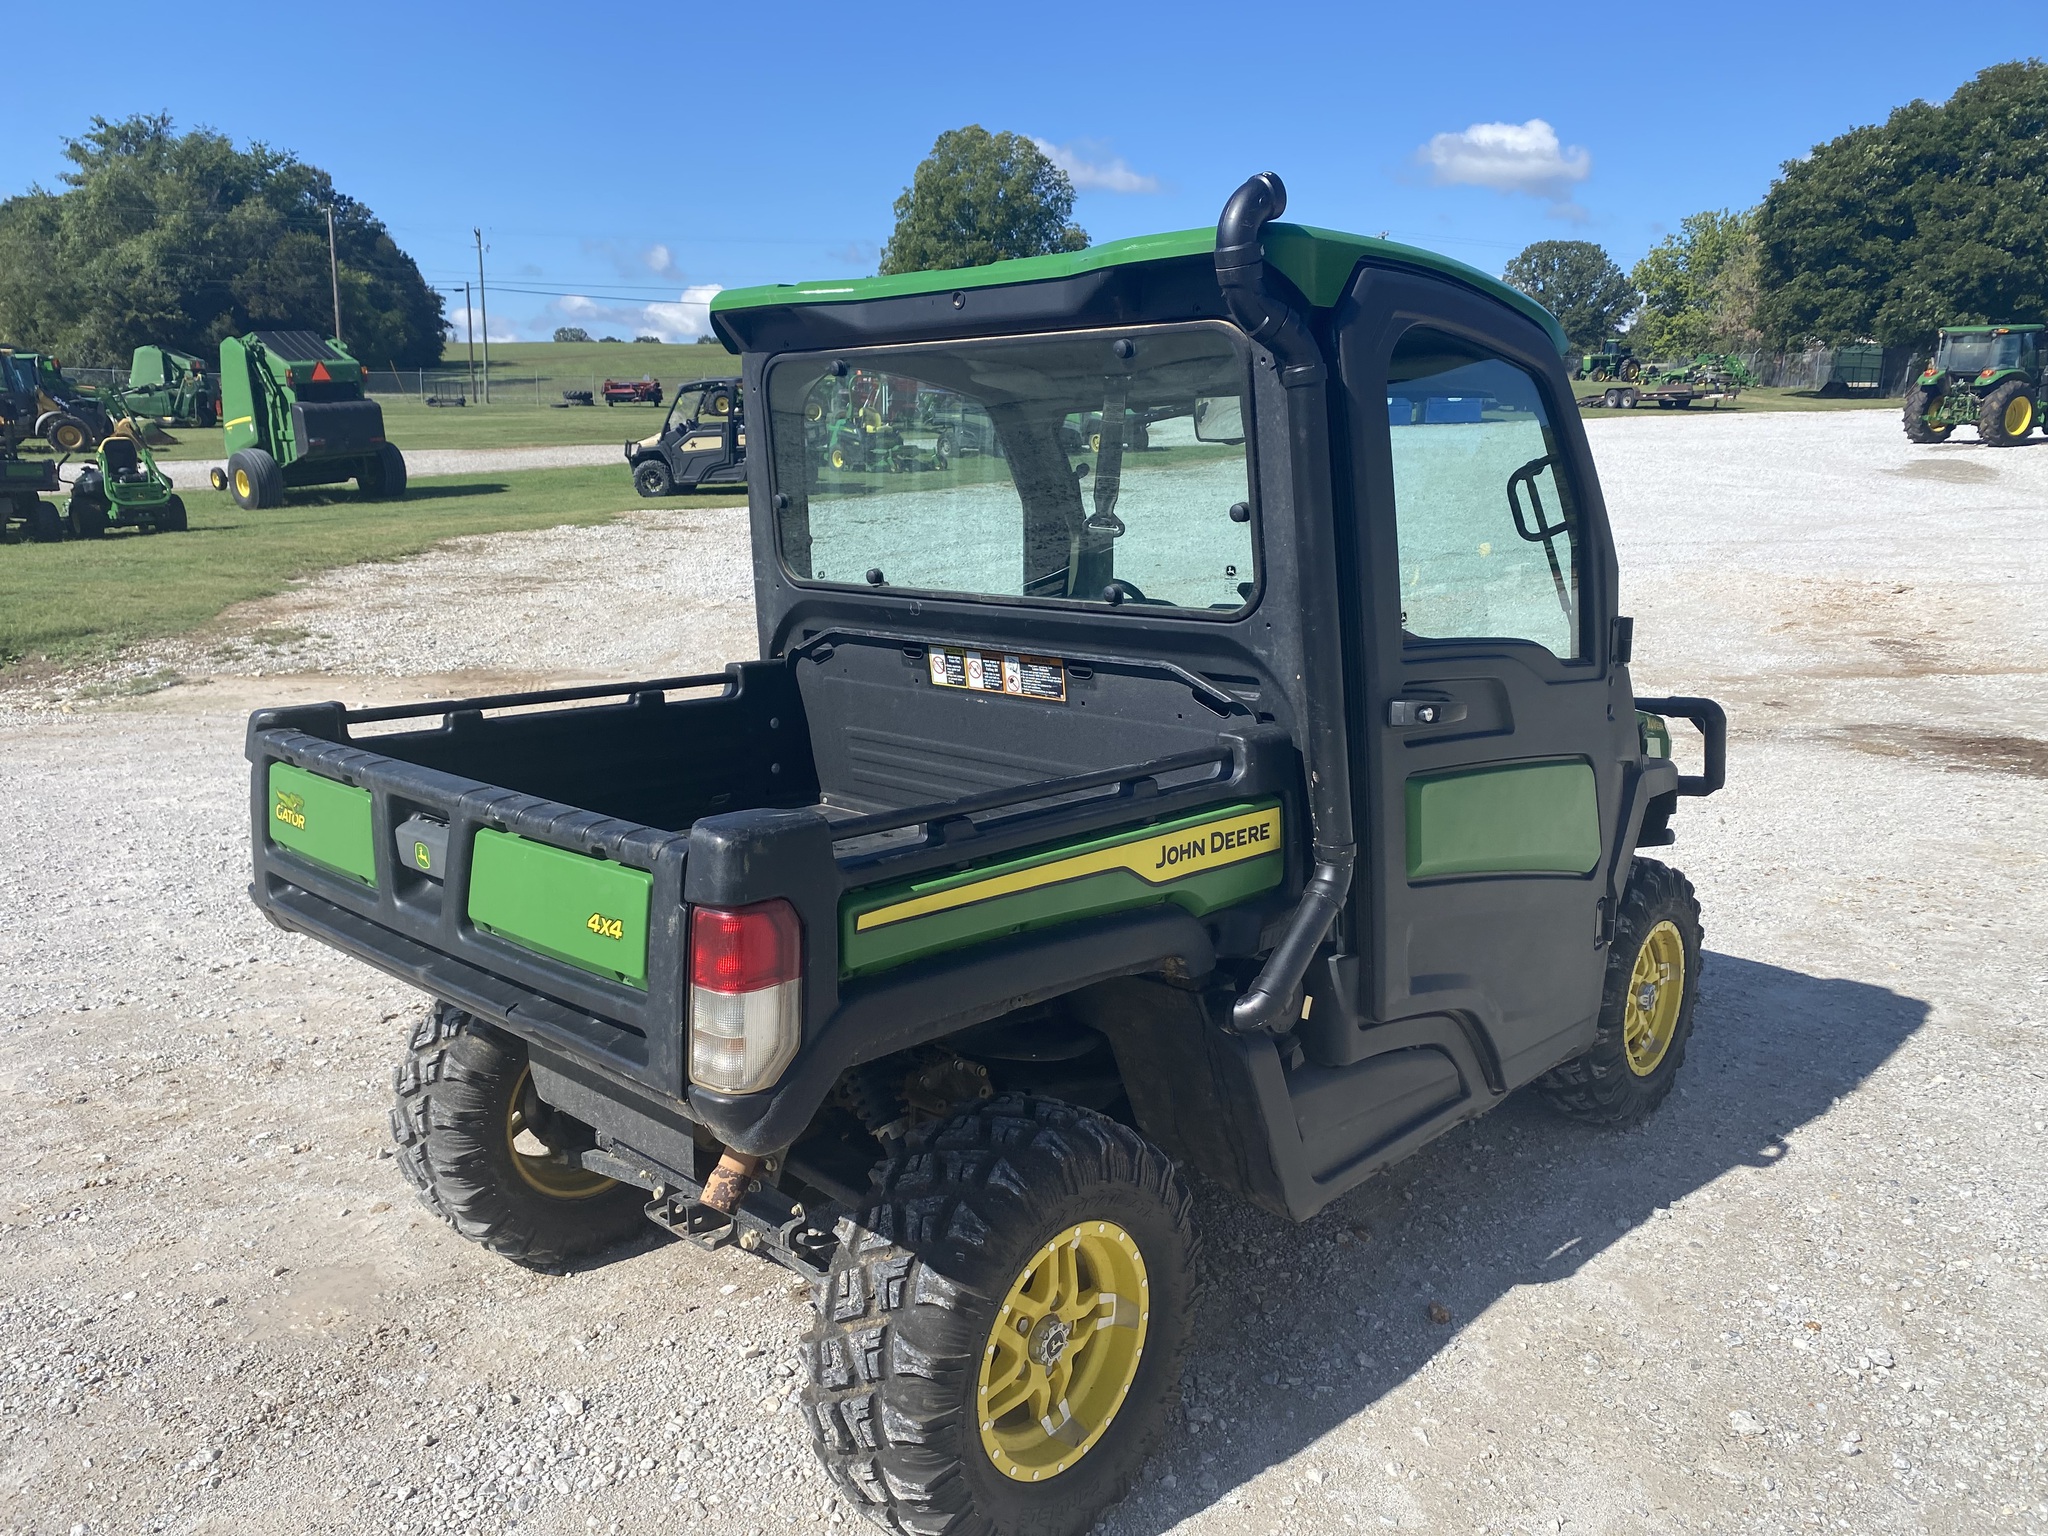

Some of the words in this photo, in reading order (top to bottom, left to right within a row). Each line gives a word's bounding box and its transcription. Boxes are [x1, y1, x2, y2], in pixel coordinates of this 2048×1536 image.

[276, 804, 306, 830] GATOR
[1155, 838, 1206, 869] JOHN
[1210, 822, 1270, 854] DEERE
